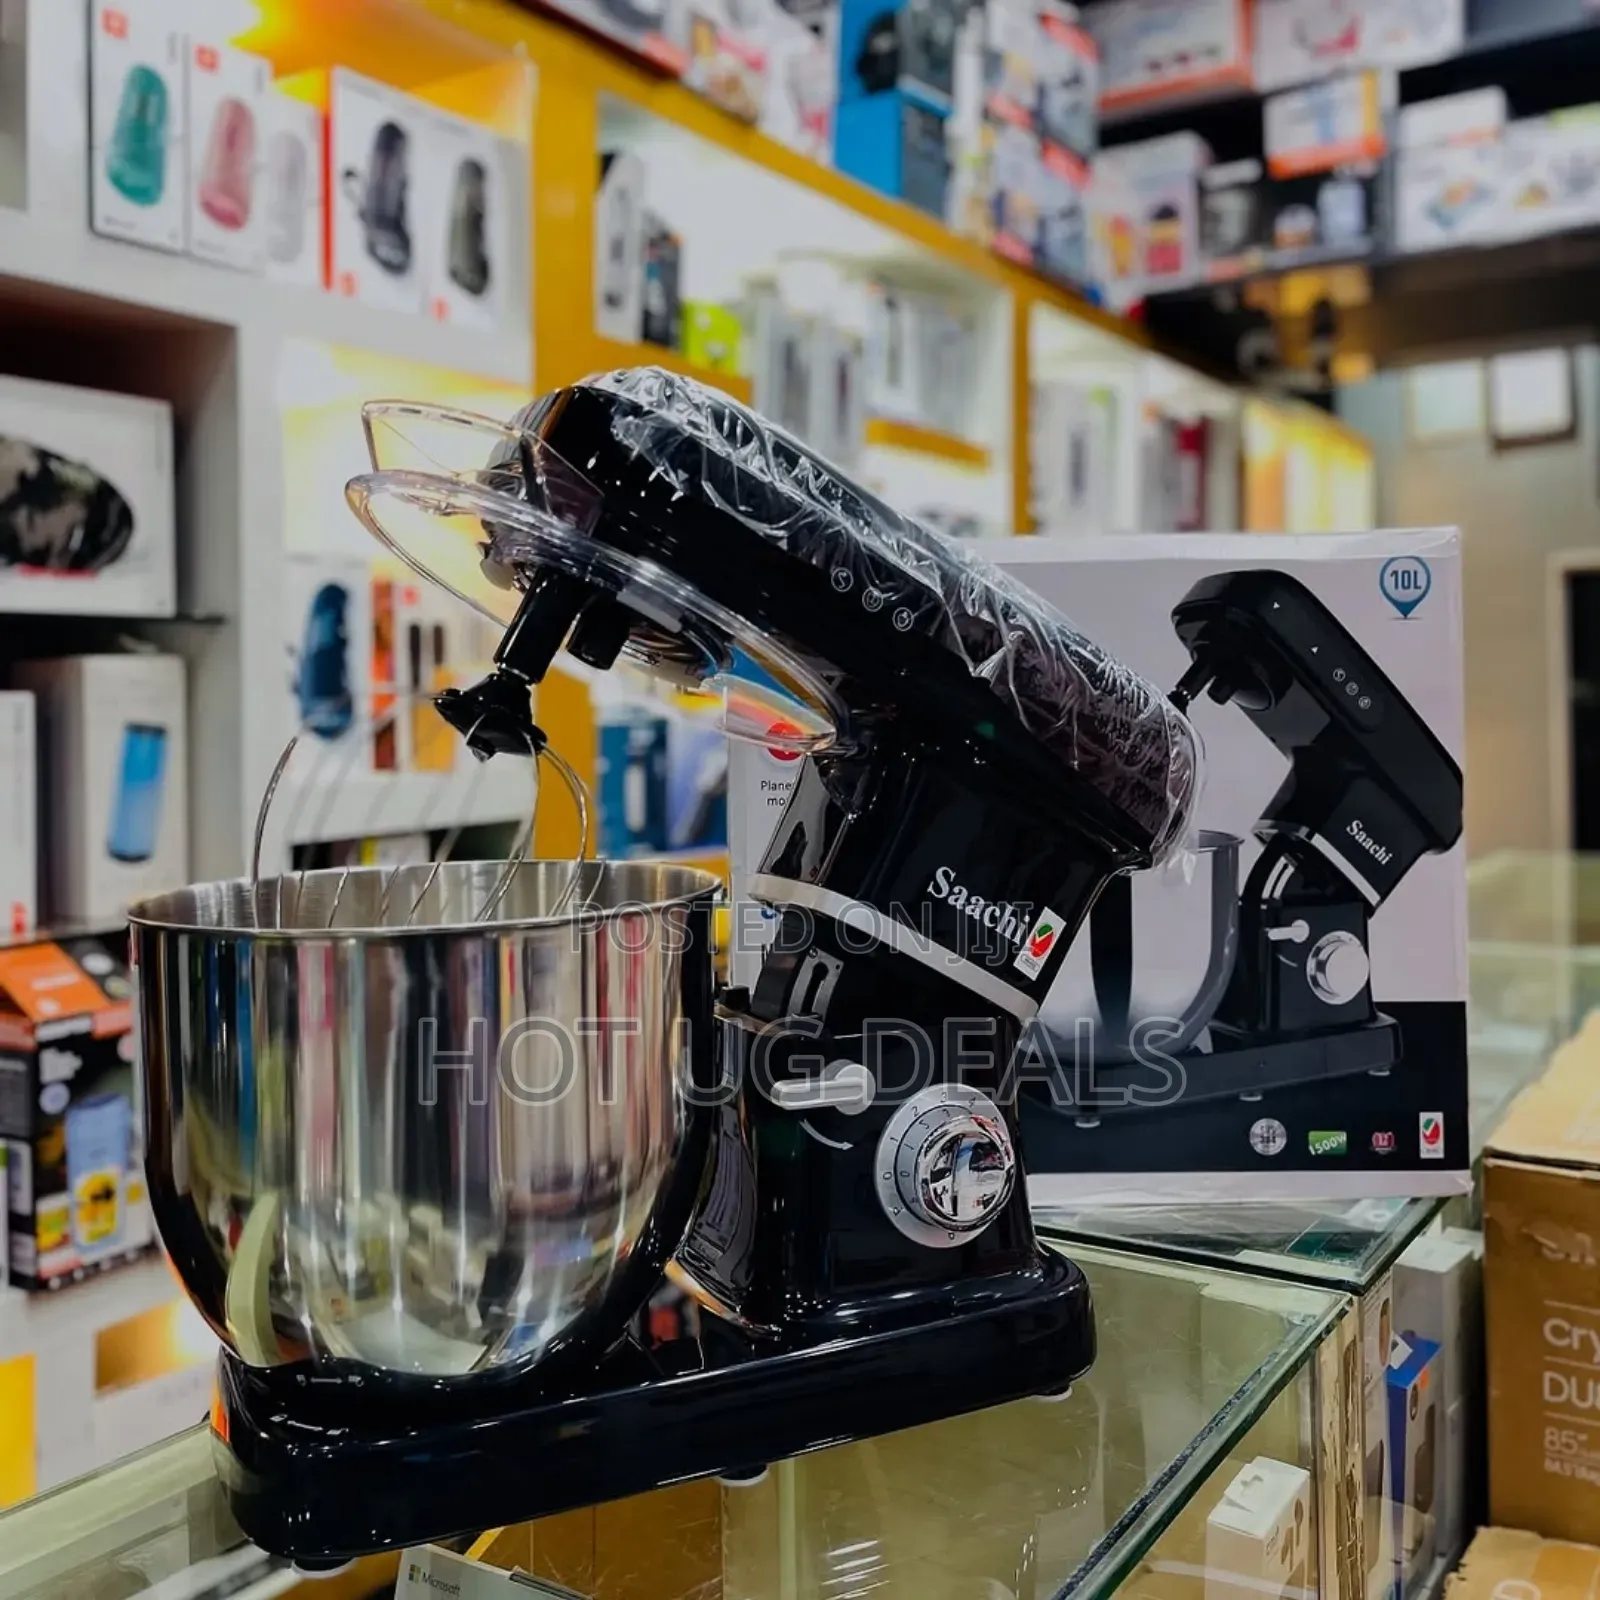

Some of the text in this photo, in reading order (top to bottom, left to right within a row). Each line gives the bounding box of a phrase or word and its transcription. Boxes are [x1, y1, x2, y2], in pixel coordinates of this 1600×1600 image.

[1389, 569, 1423, 592] 10L
[760, 780, 792, 792] Plane
[1345, 819, 1394, 866] Saachi
[926, 866, 1031, 945] Saachi
[1308, 1131, 1347, 1156] 1500W
[1543, 1371, 1600, 1410] DU
[422, 1572, 461, 1597] Microsoft
